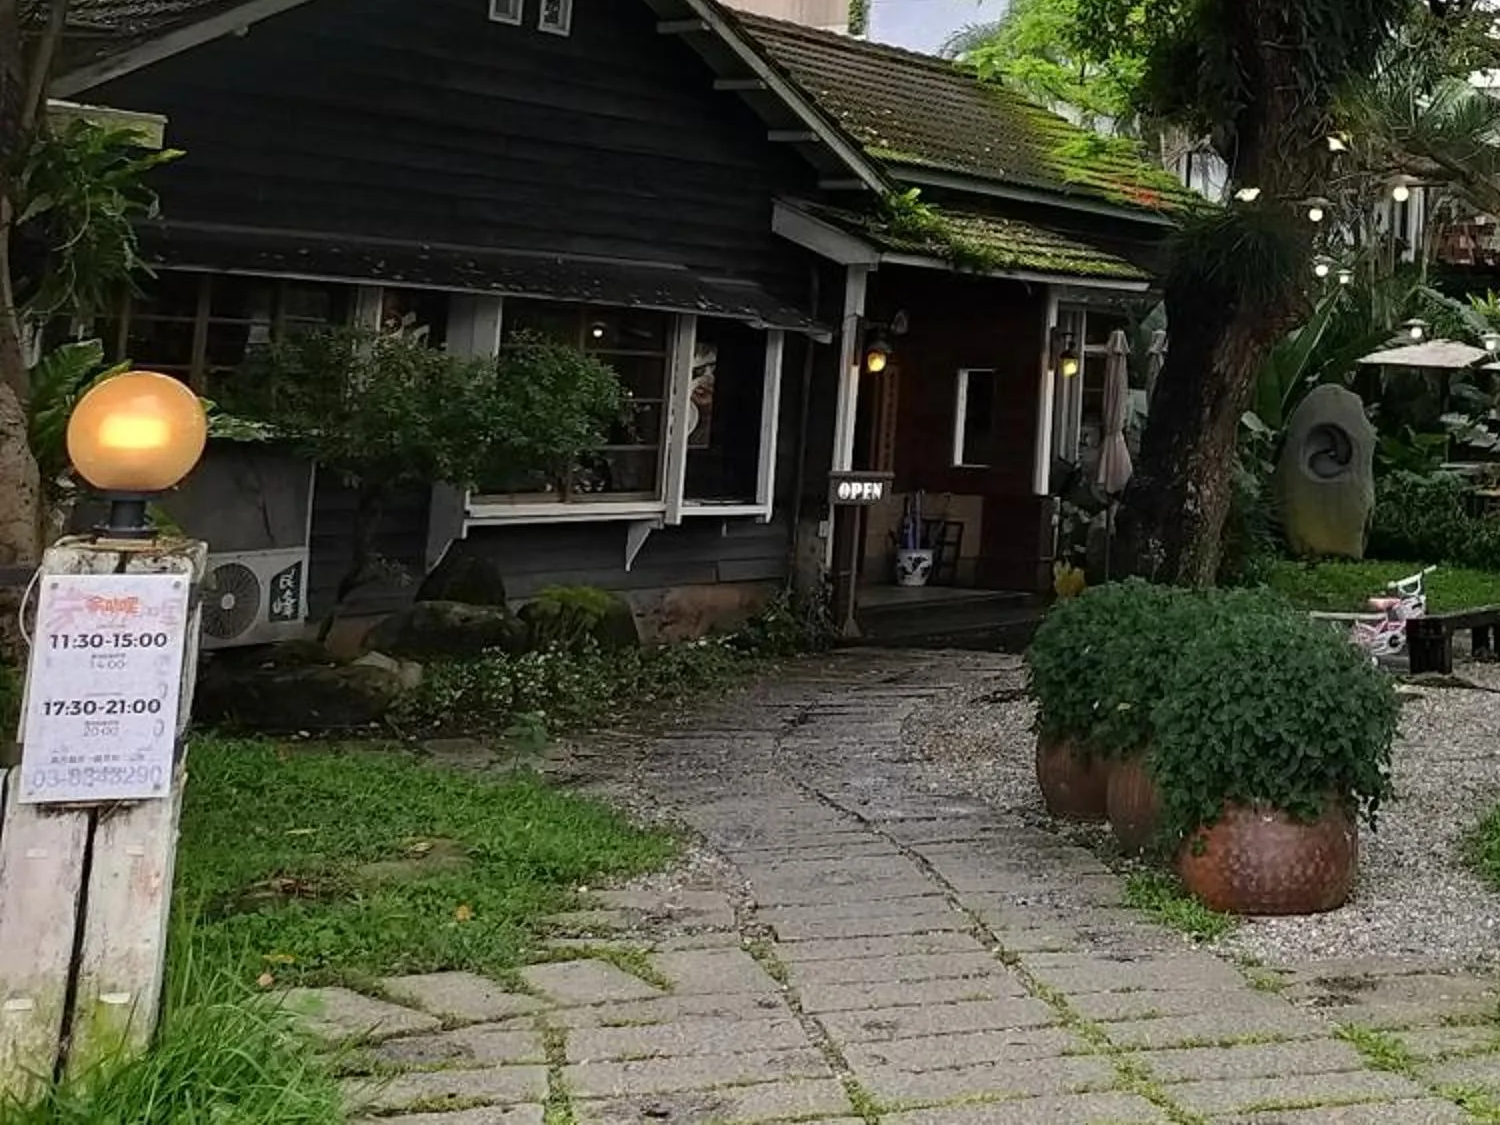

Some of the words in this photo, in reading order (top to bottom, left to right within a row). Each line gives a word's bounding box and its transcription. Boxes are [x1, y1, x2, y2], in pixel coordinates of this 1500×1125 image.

[837, 481, 883, 500] OPEN
[50, 632, 168, 650] 11:30-15:00
[43, 698, 162, 716] 17:30-21:00
